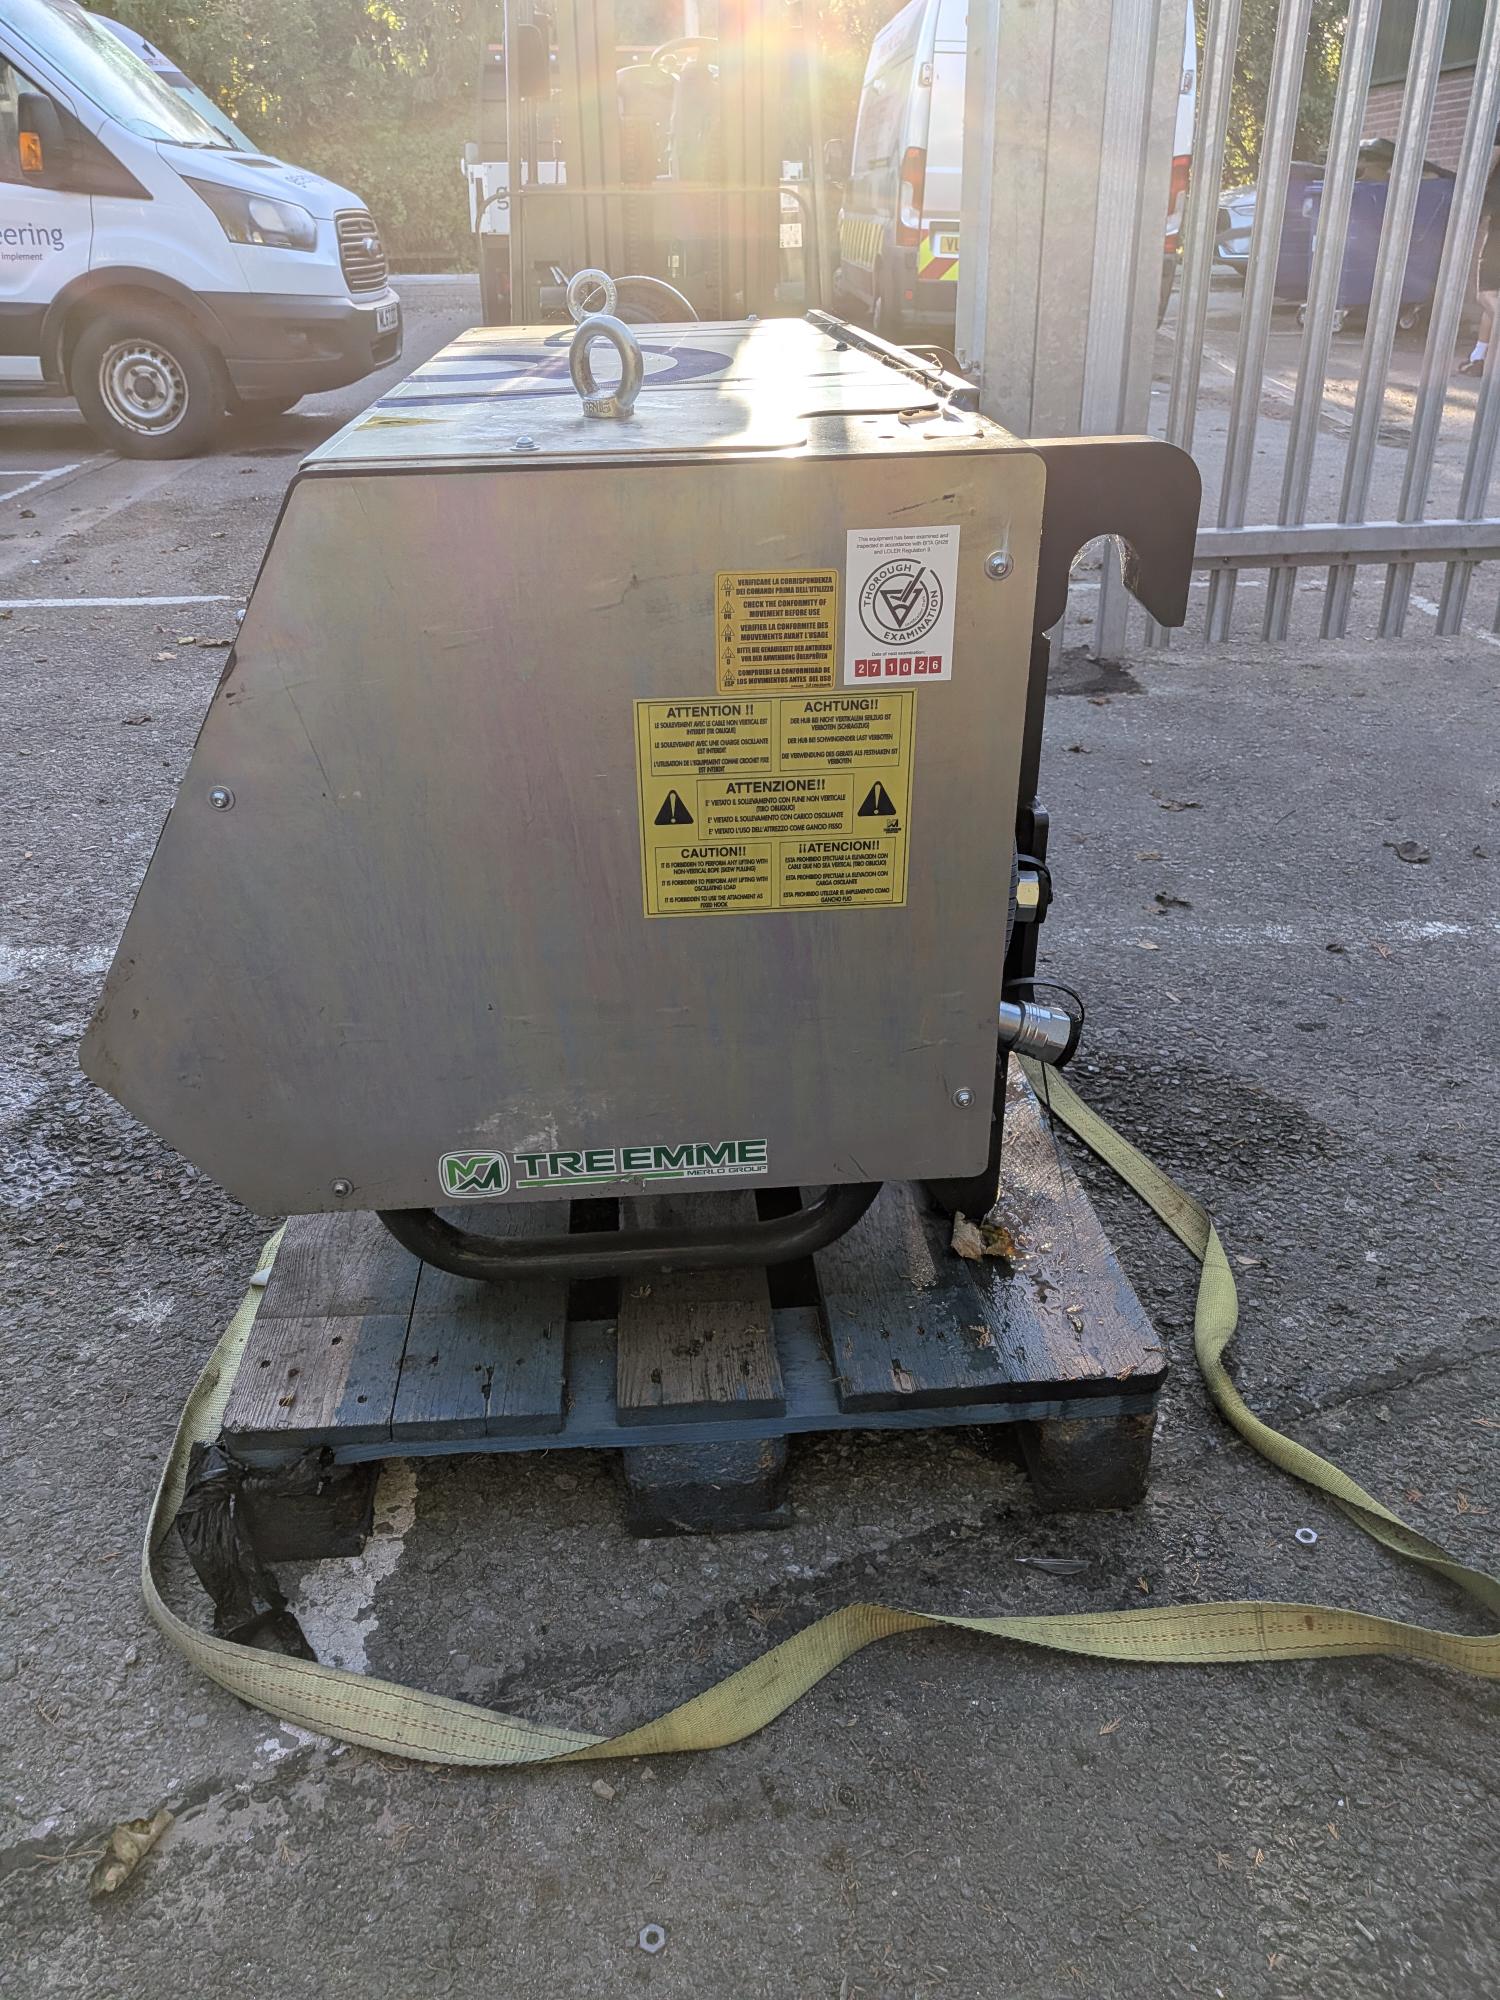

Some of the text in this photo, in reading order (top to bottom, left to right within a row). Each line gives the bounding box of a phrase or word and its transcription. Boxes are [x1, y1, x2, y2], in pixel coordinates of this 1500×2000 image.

[0, 222, 64, 251] eering
[2, 253, 43, 262] implement
[780, 577, 832, 585] CORRISPONDENZA
[863, 564, 912, 607] THOROUGH
[883, 590, 939, 641] EXAMINATION
[858, 661, 938, 673] 27 10 26
[667, 704, 753, 718] ATTENTION !!
[804, 699, 878, 712] ACHTUNG!!
[726, 779, 825, 794] ATTENZIONE!!
[681, 847, 746, 858] CAUTION!!
[516, 1140, 767, 1177] TRE EMME
[687, 1164, 767, 1176] MERLO GROUP
